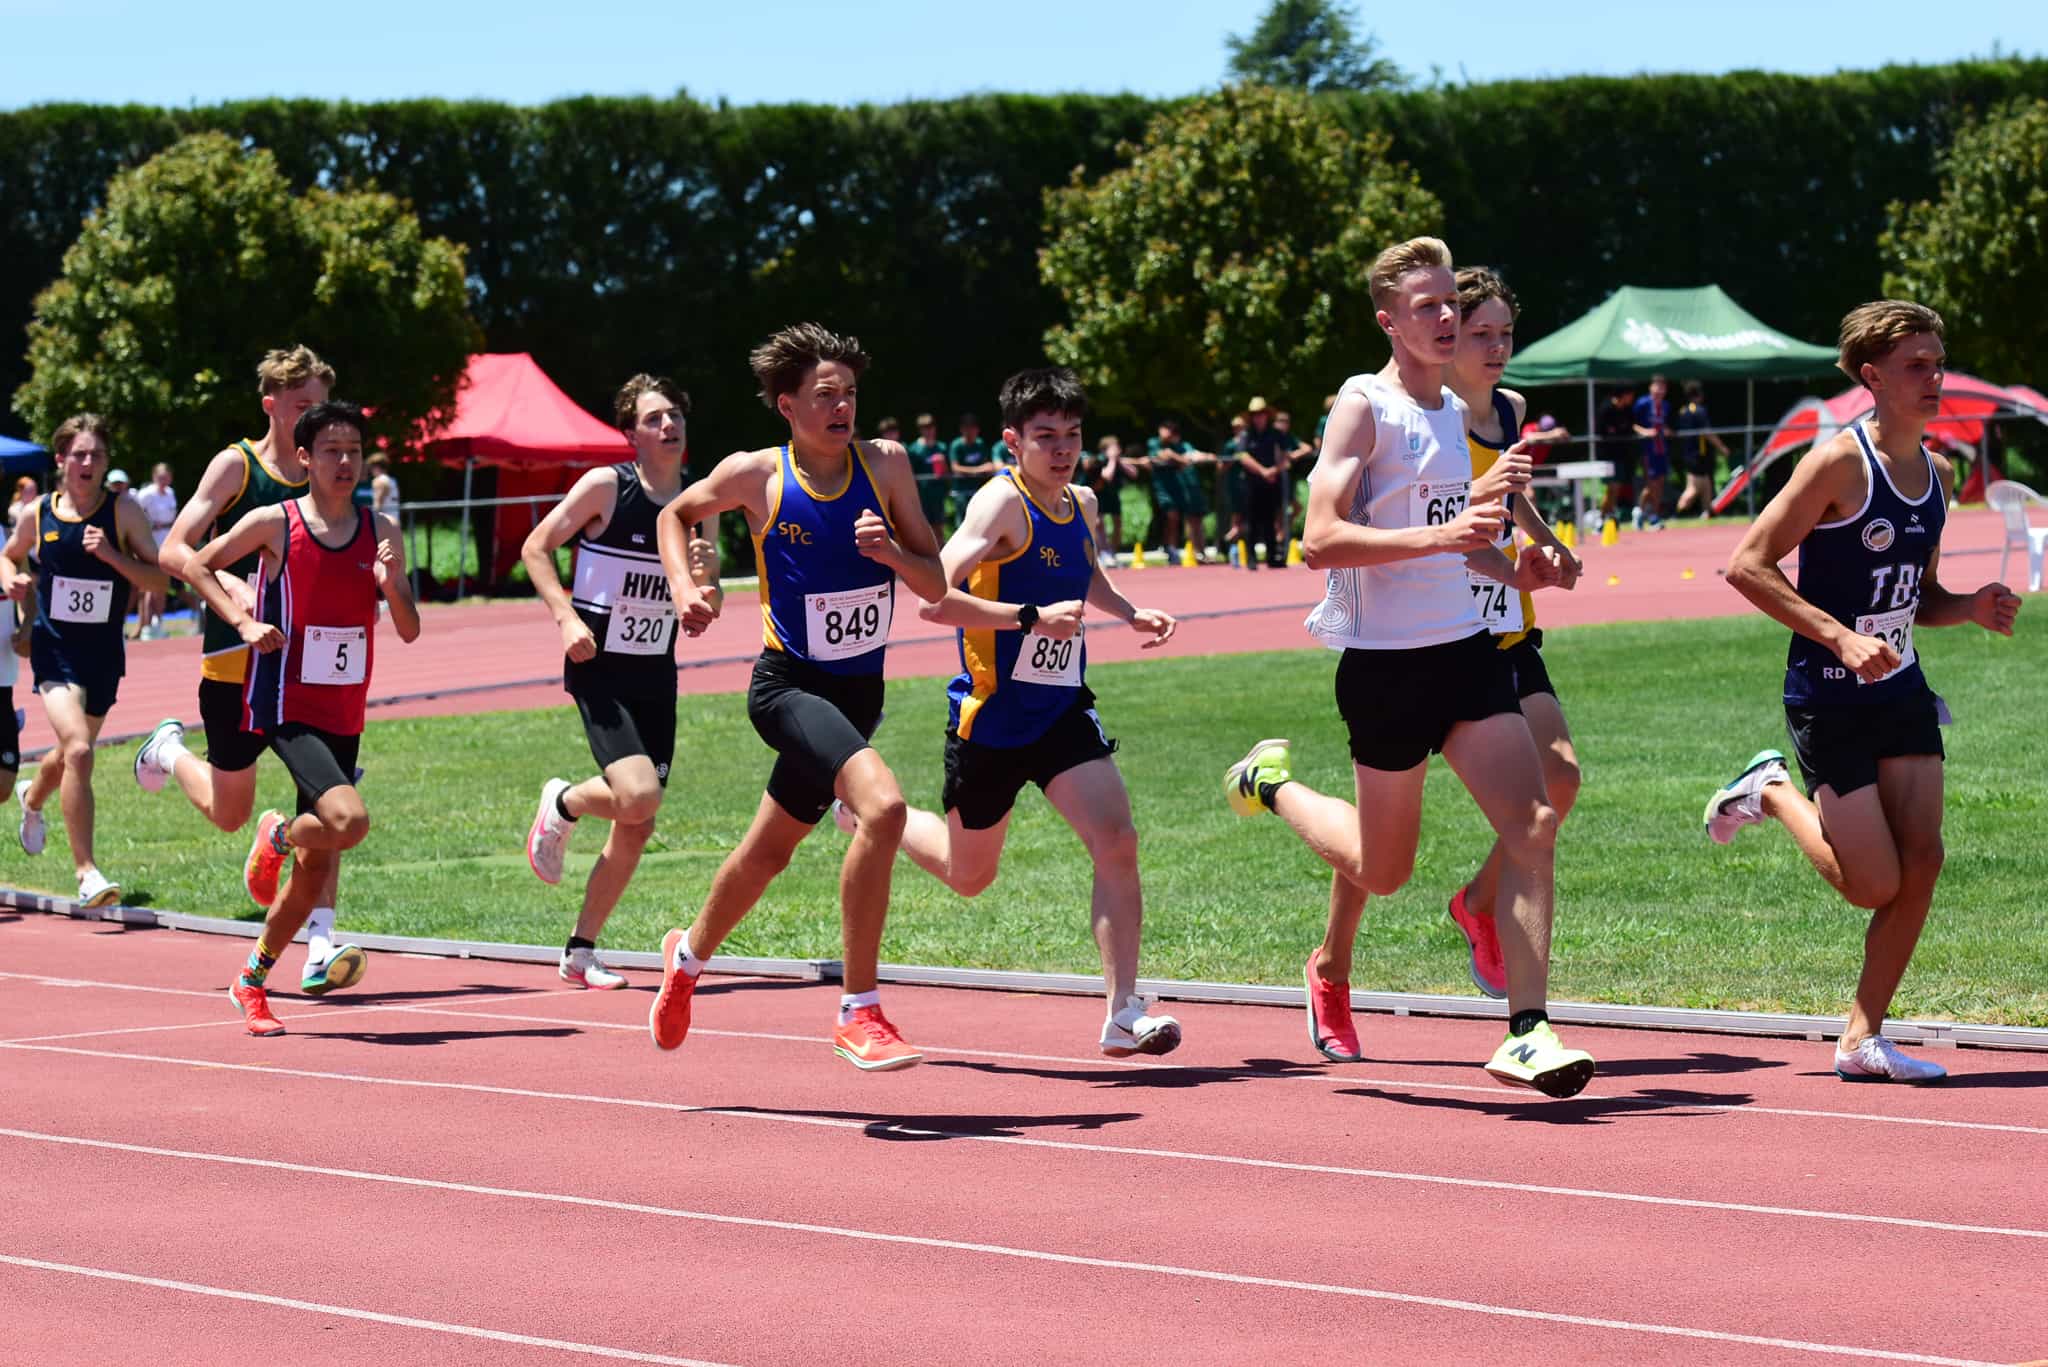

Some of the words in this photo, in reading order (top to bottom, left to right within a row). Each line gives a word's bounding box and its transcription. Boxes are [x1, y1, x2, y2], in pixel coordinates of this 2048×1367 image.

[778, 521, 814, 545] SPC
[1040, 545, 1062, 567] SPC
[1871, 564, 1923, 608] TB
[68, 590, 94, 613] 38
[621, 616, 663, 643] 320
[825, 603, 879, 645] 849
[335, 643, 348, 671] 5
[1031, 637, 1072, 671] 850
[1823, 667, 1846, 679] RD
